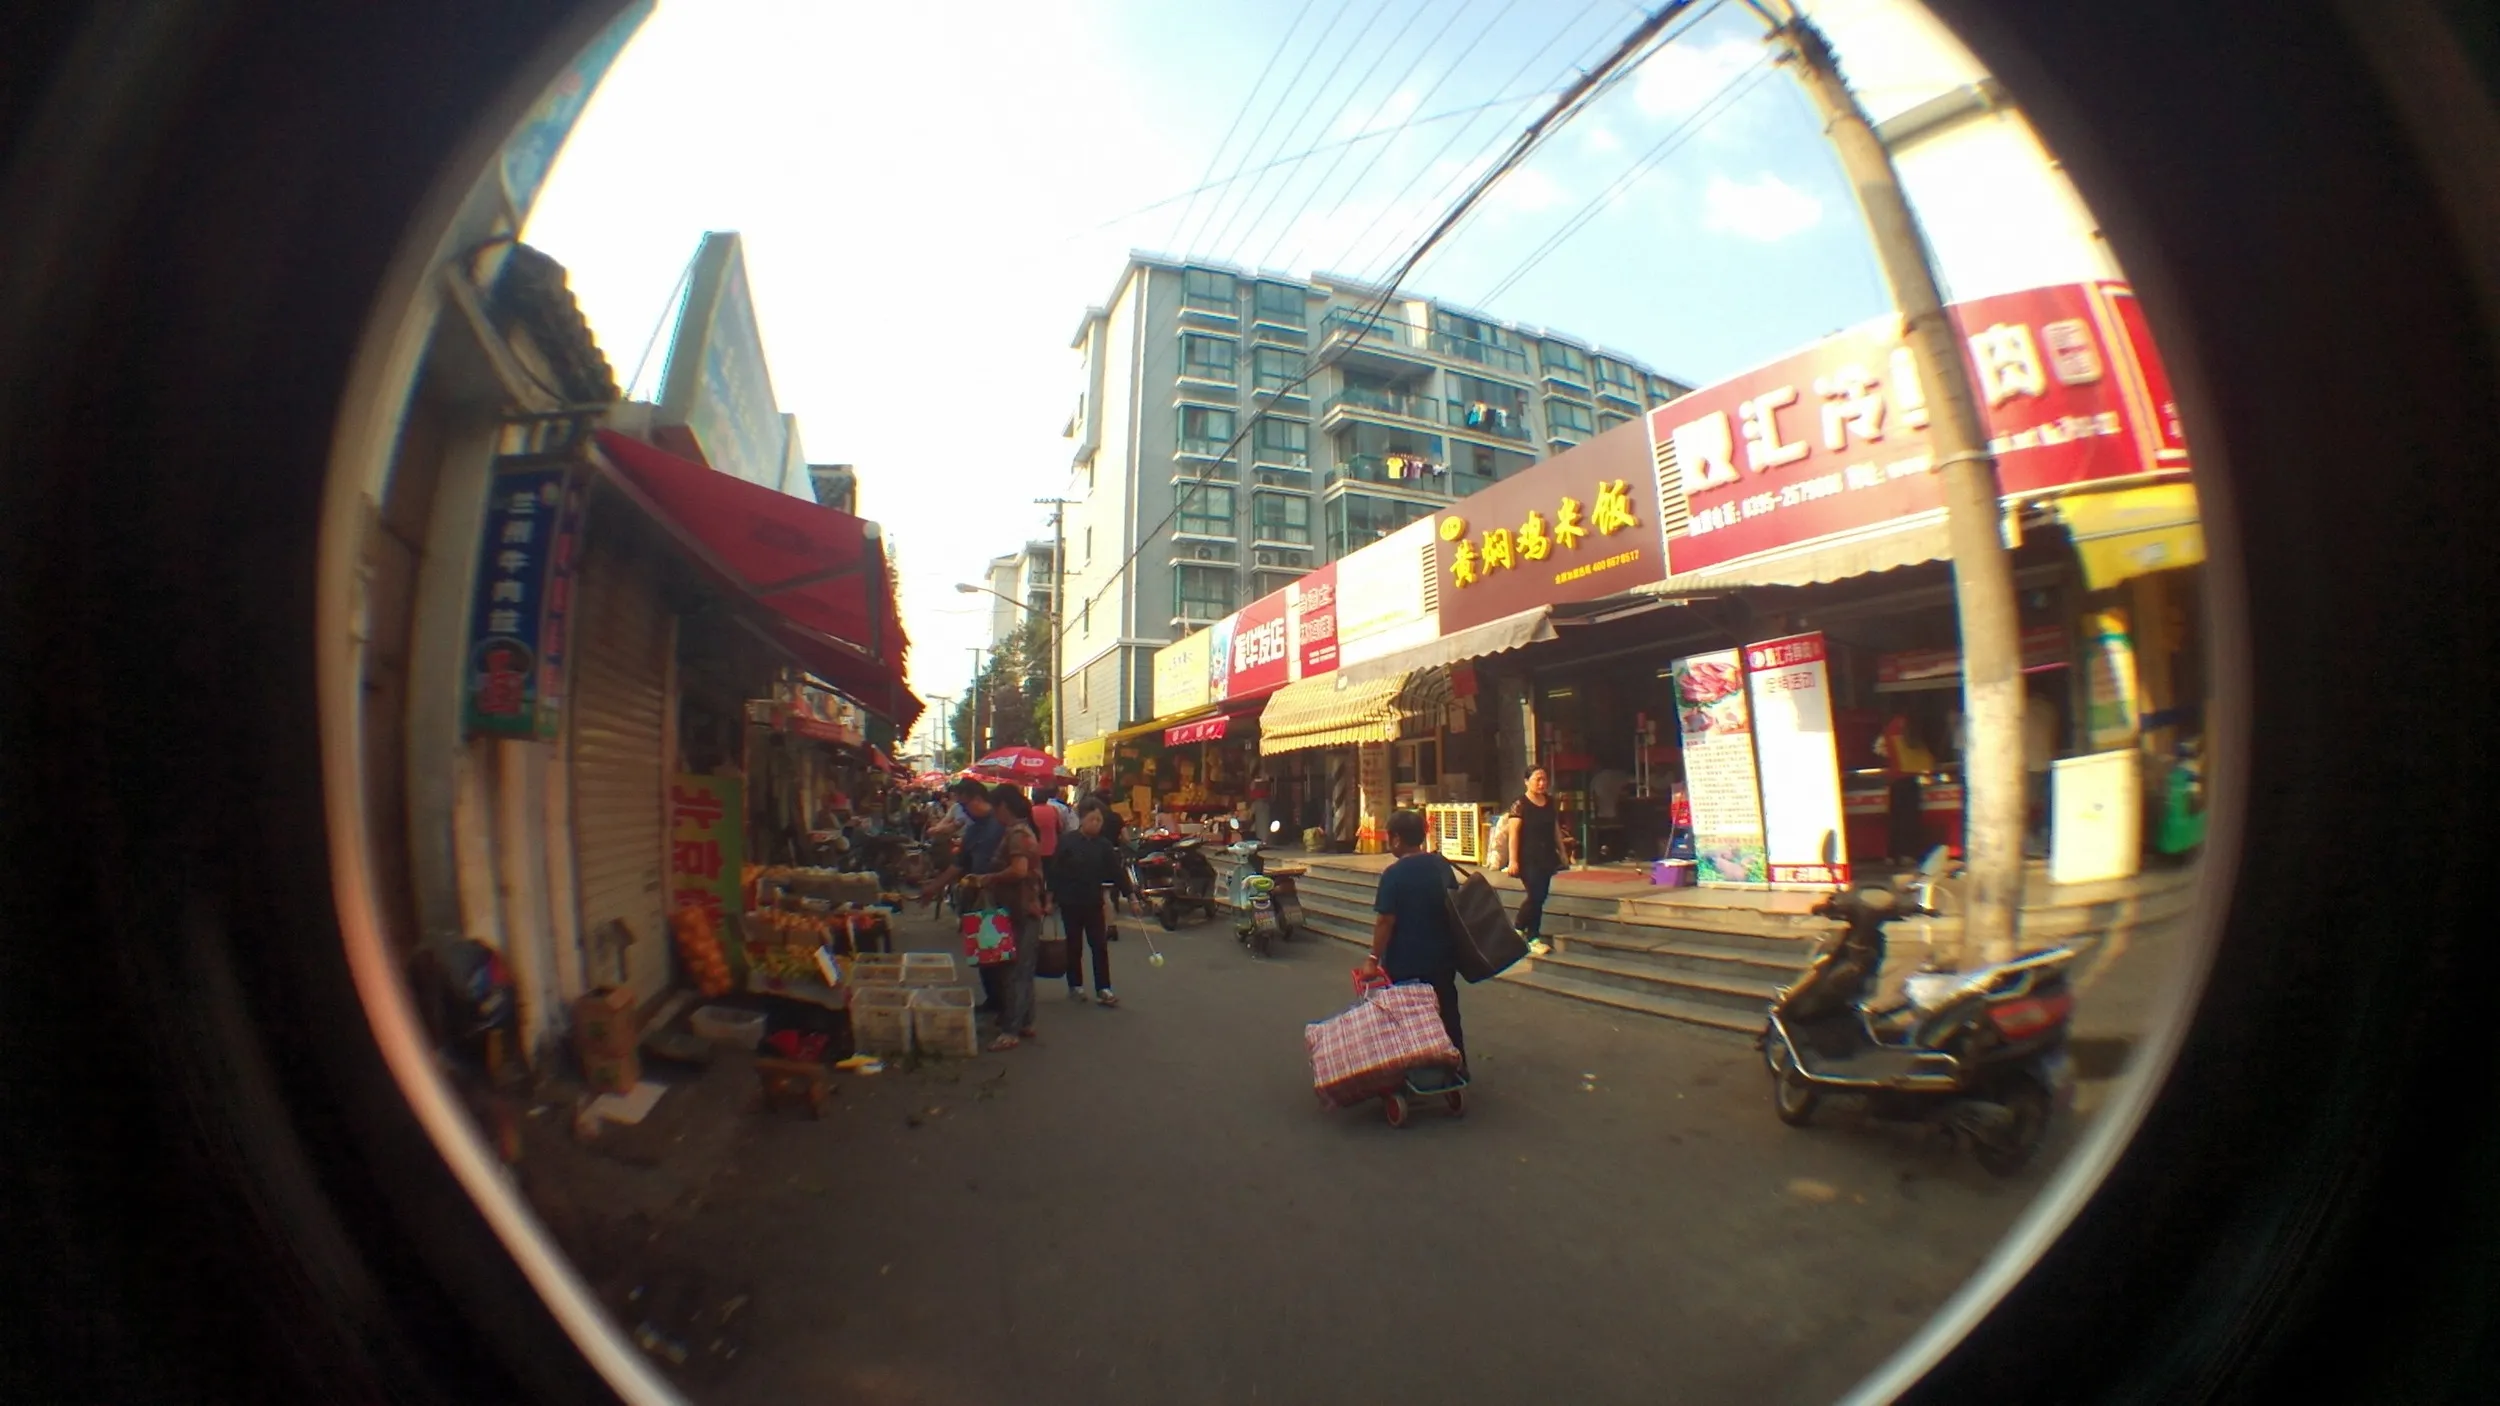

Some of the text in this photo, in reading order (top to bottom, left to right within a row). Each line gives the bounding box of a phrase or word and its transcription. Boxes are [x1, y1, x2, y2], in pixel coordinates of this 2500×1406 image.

[1450, 478, 1639, 589] 黄焖鸡米饭
